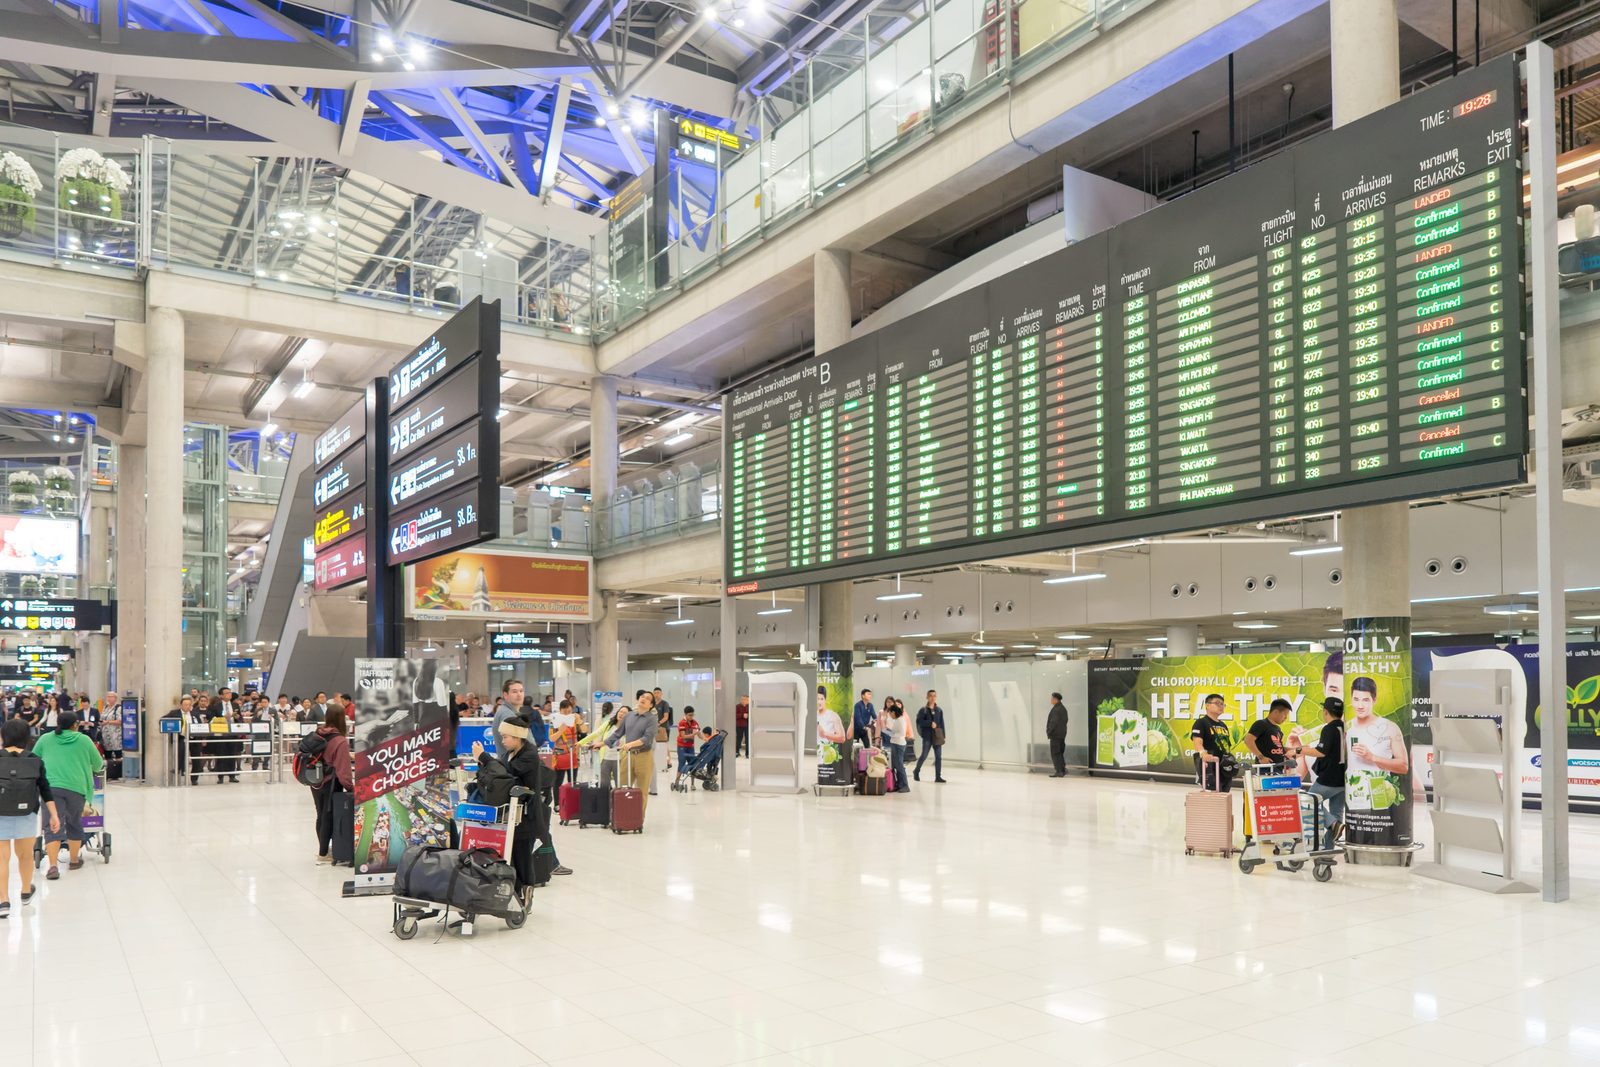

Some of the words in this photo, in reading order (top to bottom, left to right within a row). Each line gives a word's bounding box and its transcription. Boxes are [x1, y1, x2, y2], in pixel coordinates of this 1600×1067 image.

[1459, 93, 1491, 116] 19:28
[1420, 110, 1445, 131] TIME
[1487, 127, 1511, 146] ประตู
[1420, 147, 1459, 171] หมายเหตุ
[1487, 144, 1512, 165] EXIT
[1342, 174, 1392, 201] เวลาที่แน่นอน
[1414, 162, 1466, 192] REMARKS
[1345, 191, 1387, 217] ARRIVES
[1352, 215, 1376, 231] 19:10
[1414, 188, 1451, 210] LANDED
[1487, 171, 1496, 183] B
[1261, 209, 1296, 232] สายการบิน
[1311, 214, 1325, 230] NO
[1353, 231, 1376, 248] 20:15
[1414, 203, 1459, 228] Confirmed
[1487, 190, 1496, 202] B
[1263, 226, 1294, 247] FLIGHT
[1354, 249, 1377, 265] 19:35
[1415, 221, 1460, 246] Confirmed
[1488, 209, 1496, 221] B
[1193, 255, 1216, 273] FROM
[1354, 267, 1377, 282] 19:20
[1415, 243, 1452, 262] LANDED
[1488, 227, 1497, 240] B
[1354, 284, 1377, 299] 19:30
[1416, 258, 1460, 281] Confirmed
[1489, 246, 1498, 258] C
[1128, 282, 1144, 297] TIME
[1355, 301, 1377, 316] 19:40
[1416, 277, 1461, 299] Confirmed
[1489, 265, 1498, 277] B
[1055, 304, 1084, 324] REMARKS
[1092, 296, 1106, 311] EXIT
[1355, 318, 1378, 334] 20:55
[1417, 295, 1461, 317] Confirmed
[1490, 284, 1498, 295] C
[1016, 321, 1040, 338] ARRIVES
[1356, 335, 1378, 350] 19:35
[1417, 316, 1454, 334] LANDED
[1490, 302, 1499, 314] C
[970, 340, 988, 355] FLIGHT
[998, 334, 1007, 345] NO
[1356, 352, 1378, 367] 19:35
[1417, 332, 1462, 352] Confirmed
[1490, 321, 1499, 333] B
[820, 362, 831, 385] B
[928, 357, 943, 371] FROM
[1356, 370, 1379, 384] 19:35
[1417, 350, 1462, 371] Confirmed
[1491, 340, 1500, 352] C
[1356, 387, 1379, 401] 19:40
[1418, 368, 1463, 389] Confirmed
[1491, 359, 1500, 371] C
[733, 403, 763, 421] International
[763, 395, 783, 410] Arrivals
[783, 389, 798, 402] Door
[1419, 388, 1460, 406] Cancelled
[1357, 422, 1380, 436] 19:40
[1418, 405, 1463, 424] Confirmed
[1492, 397, 1500, 409] B
[1420, 425, 1460, 442] Cancelled
[1357, 456, 1380, 471] 19:35
[1419, 441, 1464, 460] Confirmed
[1493, 435, 1502, 447] C
[359, 669, 394, 677] TRAFFICKING
[1343, 661, 1400, 674] EALTHY
[371, 678, 394, 690] 1300
[1150, 676, 1228, 687] CHLOROPHYLL
[1234, 676, 1263, 687] PLUS
[1271, 676, 1306, 687] FIBER
[367, 743, 398, 766] YOU
[403, 727, 441, 753] MAKE
[383, 749, 424, 774] YOUR
[372, 758, 440, 793] CHOICES.
